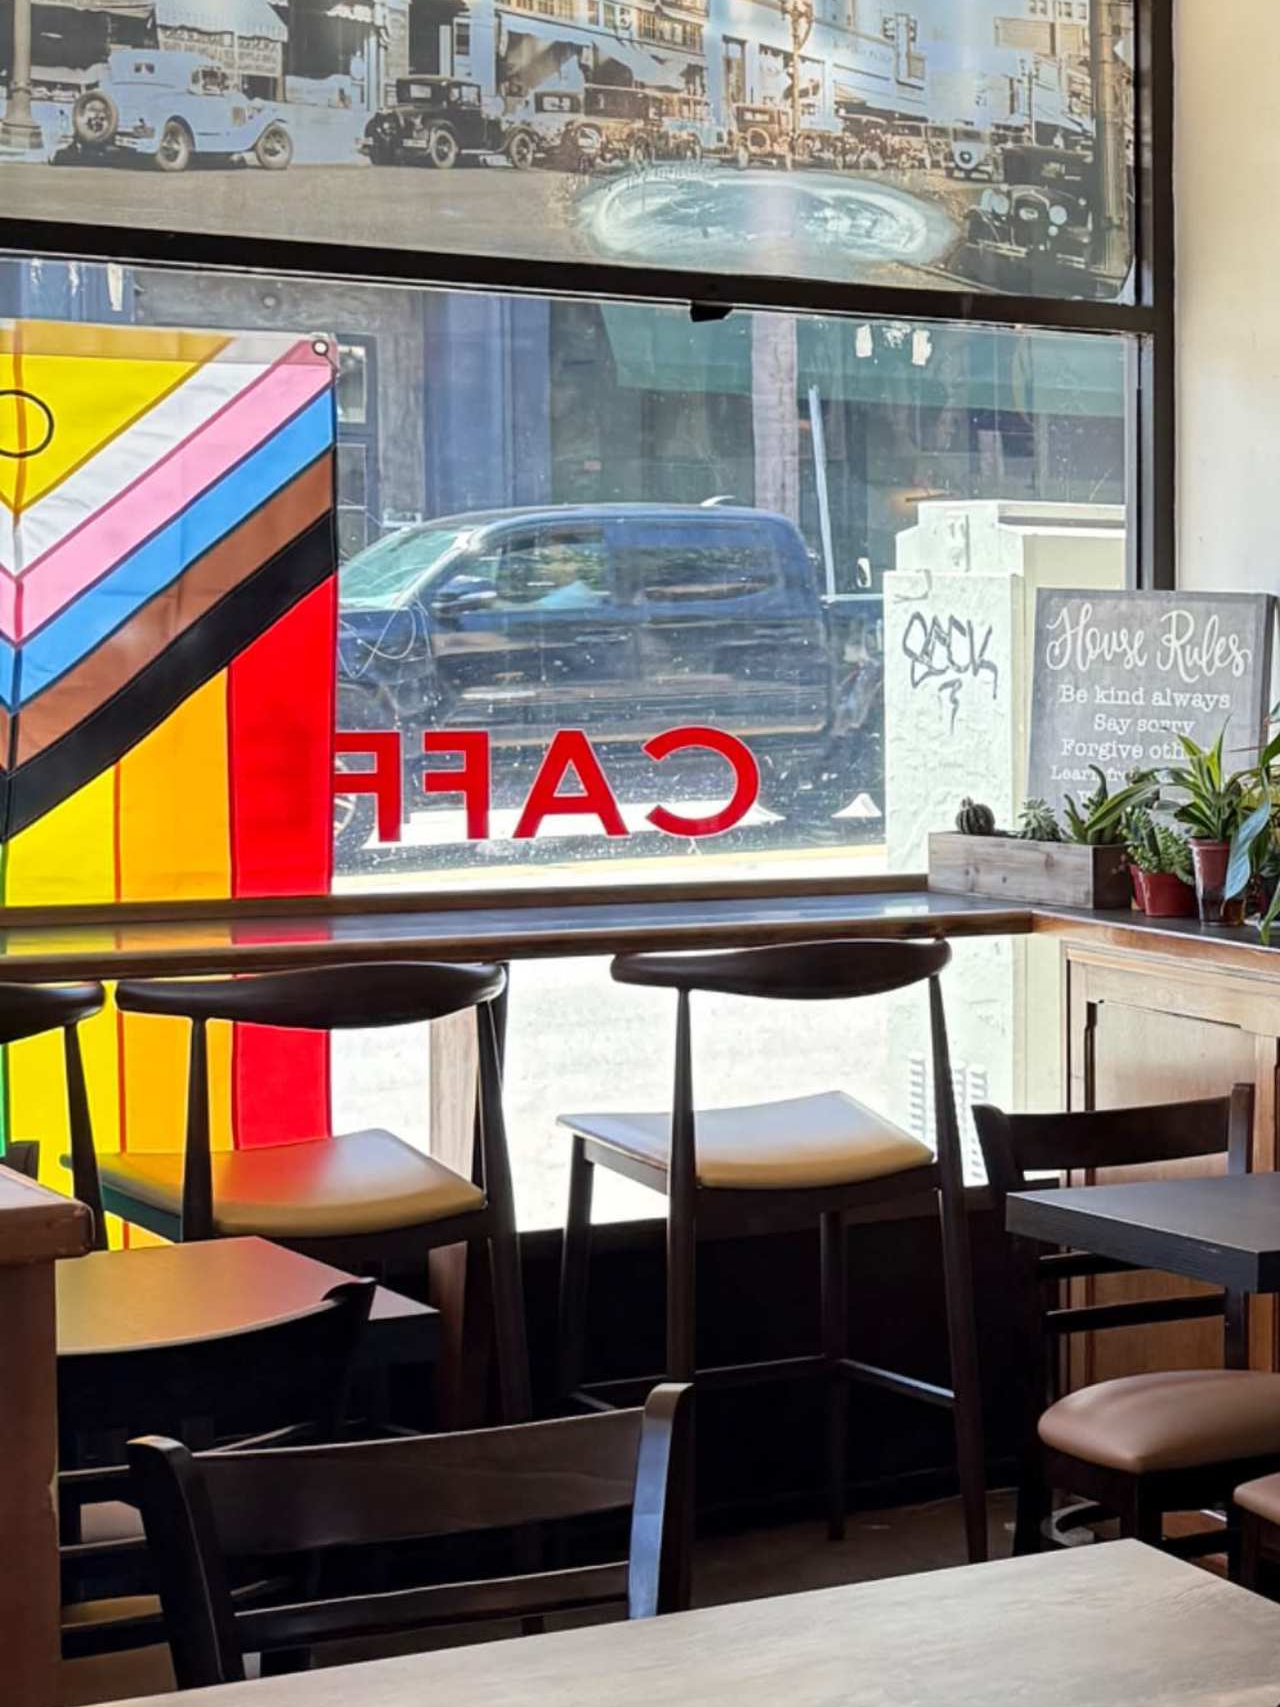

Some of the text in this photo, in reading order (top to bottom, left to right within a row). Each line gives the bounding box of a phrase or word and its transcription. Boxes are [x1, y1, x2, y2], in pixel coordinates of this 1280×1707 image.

[1046, 602, 1253, 683] House Rules
[1058, 683, 1232, 713] Be kind always
[1093, 712, 1196, 736] Say sorry
[1060, 738, 1144, 761] Forgive
